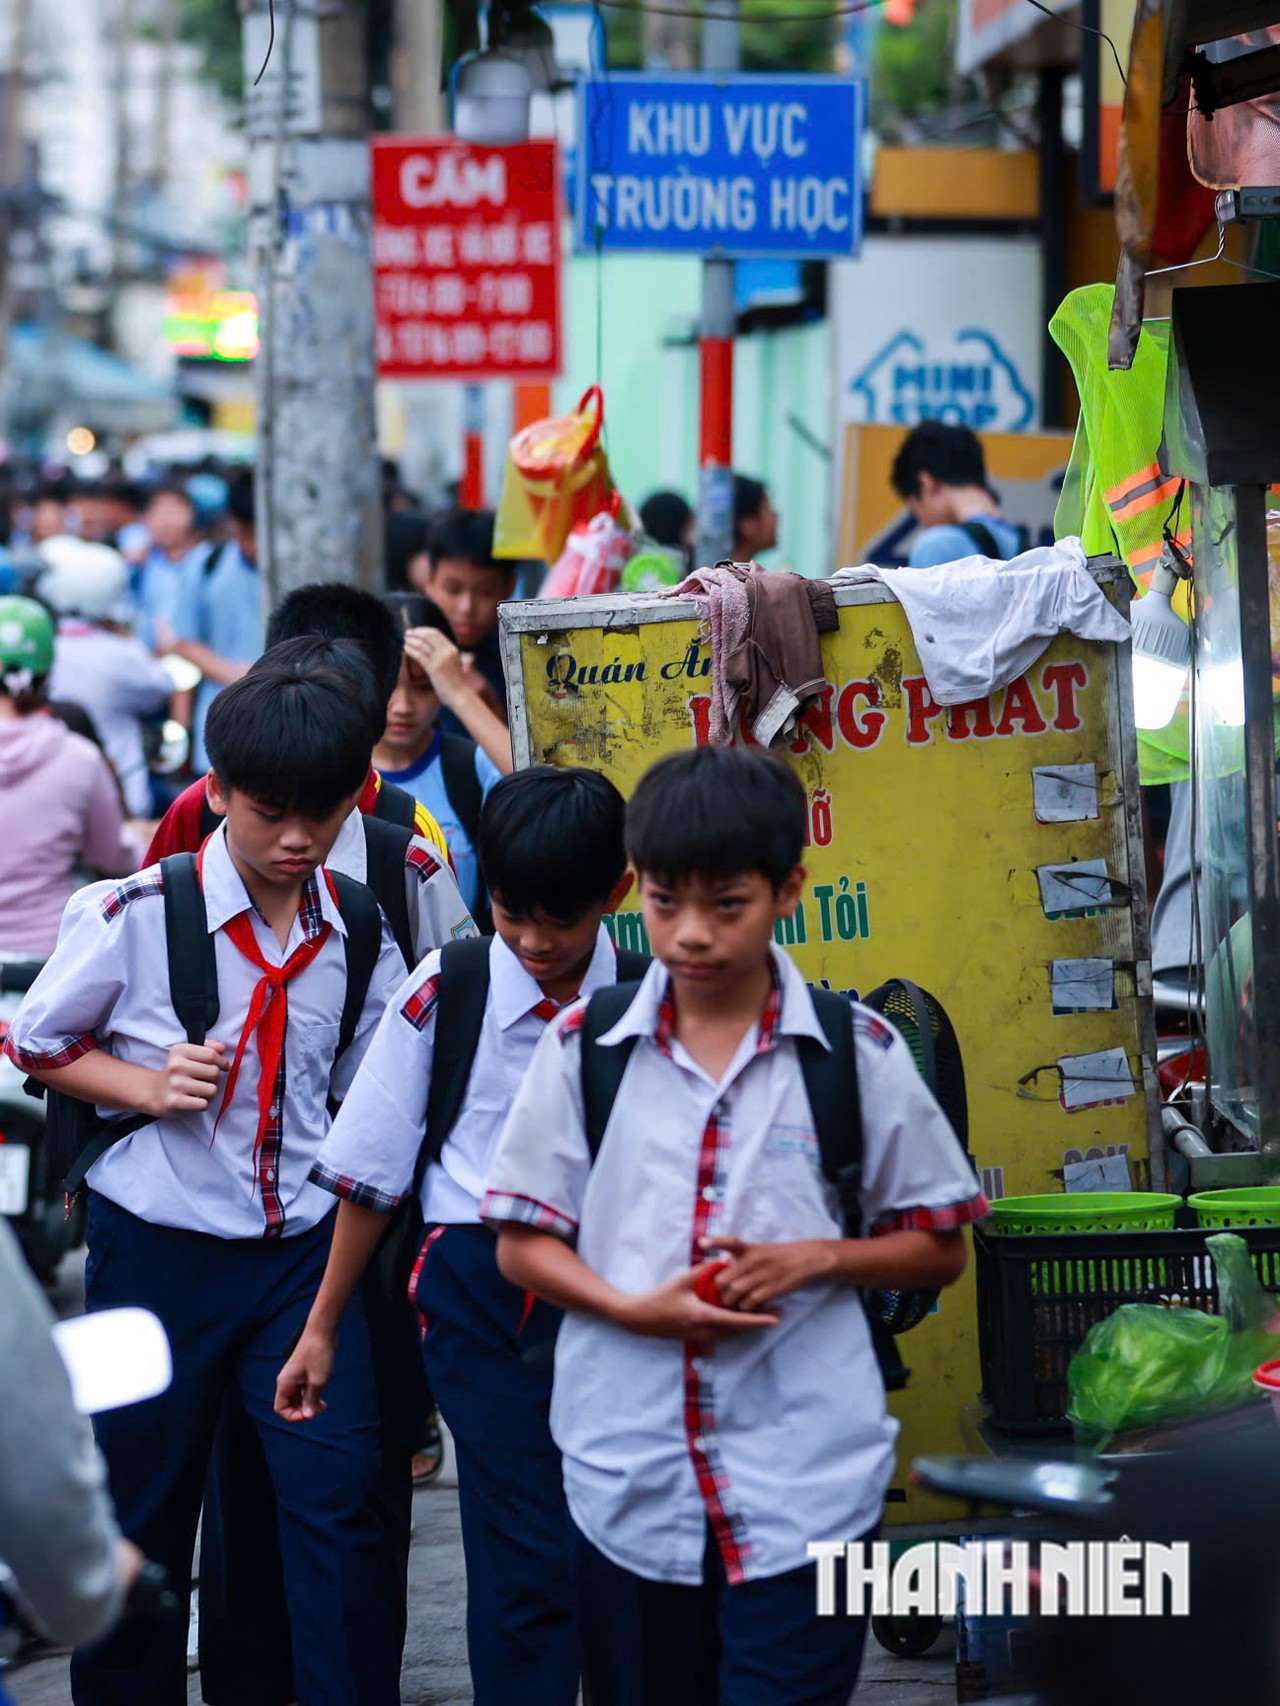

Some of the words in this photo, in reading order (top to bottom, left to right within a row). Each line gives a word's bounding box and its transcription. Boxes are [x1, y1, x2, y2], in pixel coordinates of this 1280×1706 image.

[628, 100, 711, 157] KHU
[723, 101, 808, 168] VỰC
[771, 177, 849, 240] HỌC
[894, 364, 992, 392] MINI
[546, 654, 650, 693] Quán
[813, 875, 870, 942] Tỏi
